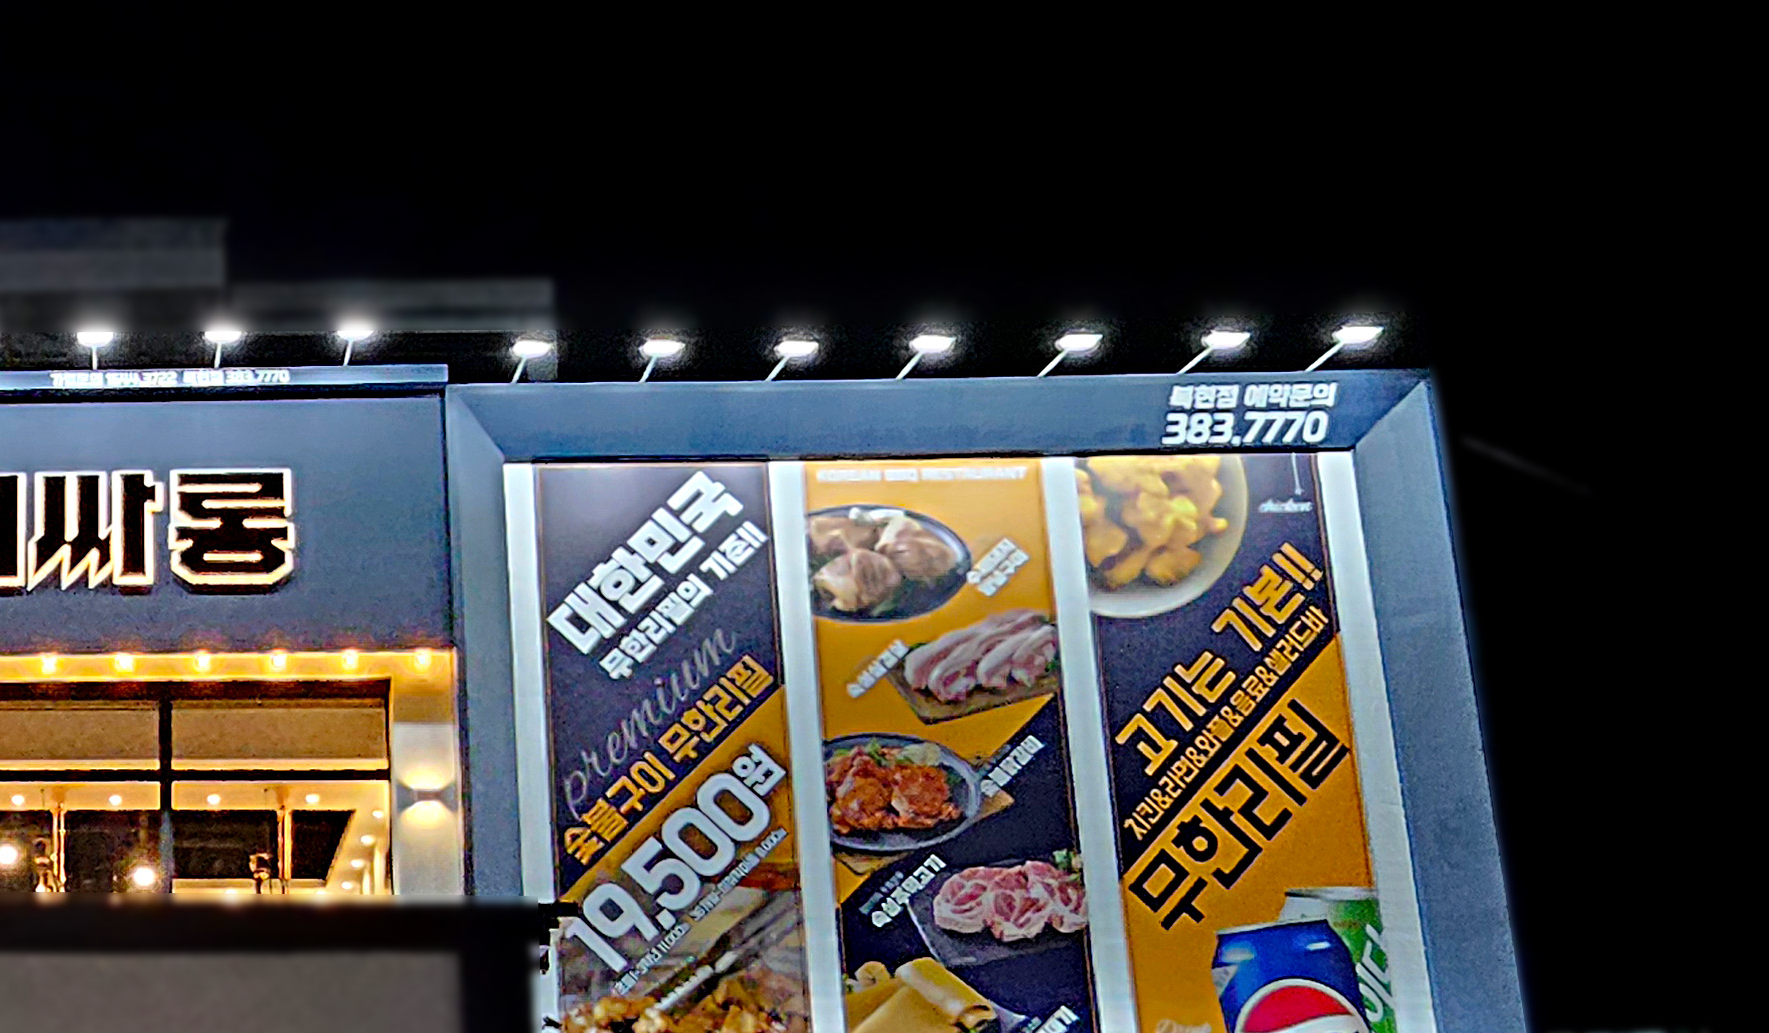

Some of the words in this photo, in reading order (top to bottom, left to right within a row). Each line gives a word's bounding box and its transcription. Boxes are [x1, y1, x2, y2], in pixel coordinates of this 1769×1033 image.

[1161, 410, 1329, 446] 383.7770
[1169, 384, 1239, 409] 복현점
[1243, 382, 1337, 408] 예약문의
[546, 470, 744, 655] 대한민국
[599, 573, 714, 680] 무한리필의
[563, 628, 737, 823] premium
[1115, 650, 1237, 777] 고기는
[1211, 542, 1324, 652] 기본!!
[563, 751, 677, 866] 숯불구이
[657, 654, 775, 763] 무한리필
[1128, 698, 1351, 931] 무한리필
